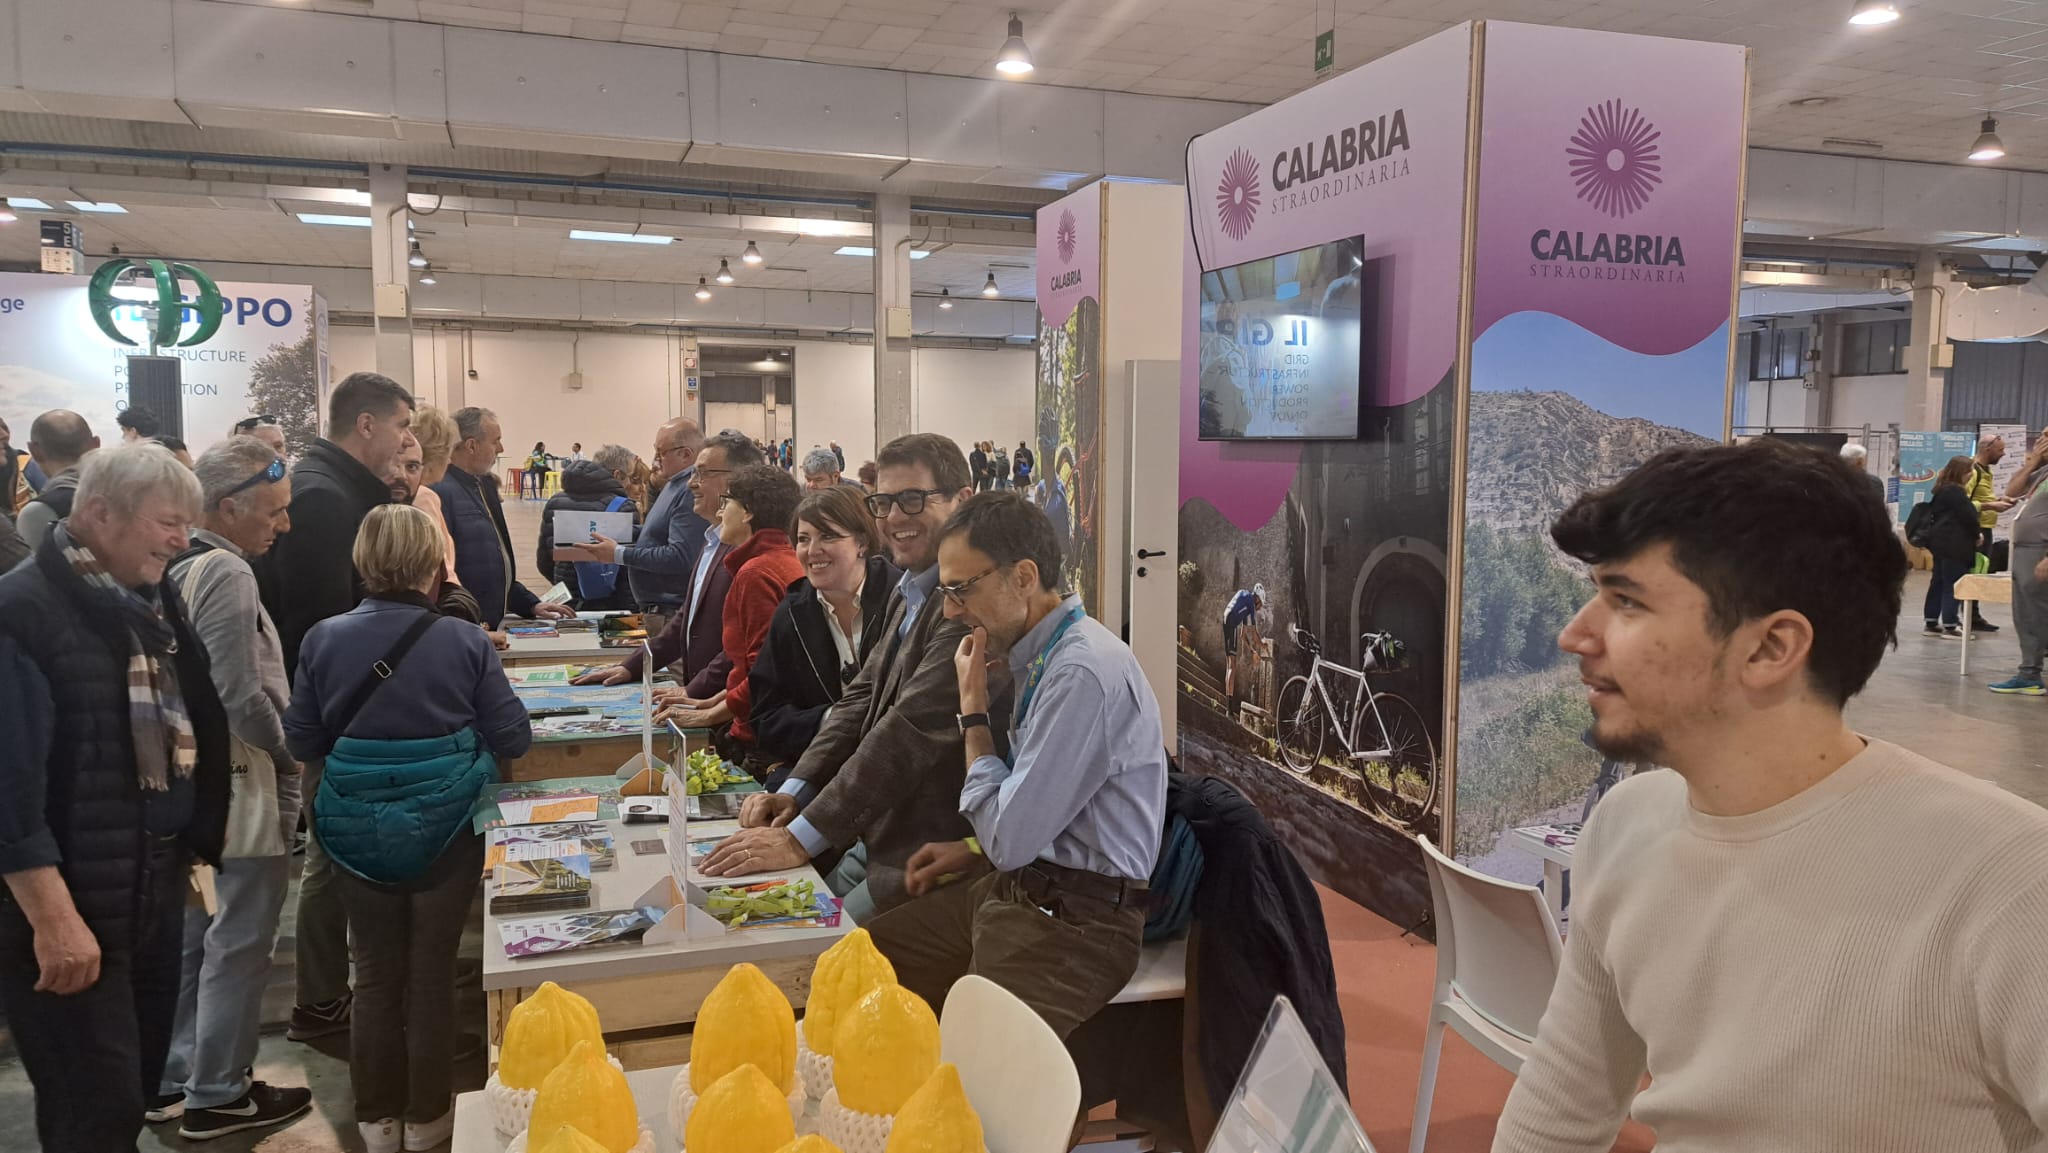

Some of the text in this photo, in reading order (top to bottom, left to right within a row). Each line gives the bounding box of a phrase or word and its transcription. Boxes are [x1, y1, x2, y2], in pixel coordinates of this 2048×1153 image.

[1272, 108, 1410, 192] CALABRIA
[1271, 157, 1410, 215] STRAORDINARIA
[1530, 228, 1686, 267] CALABRIA
[1050, 268, 1082, 291] CALABRIA
[1530, 263, 1686, 284] STRAORDINARIA
[113, 347, 247, 363] INFRSTRUCTURE
